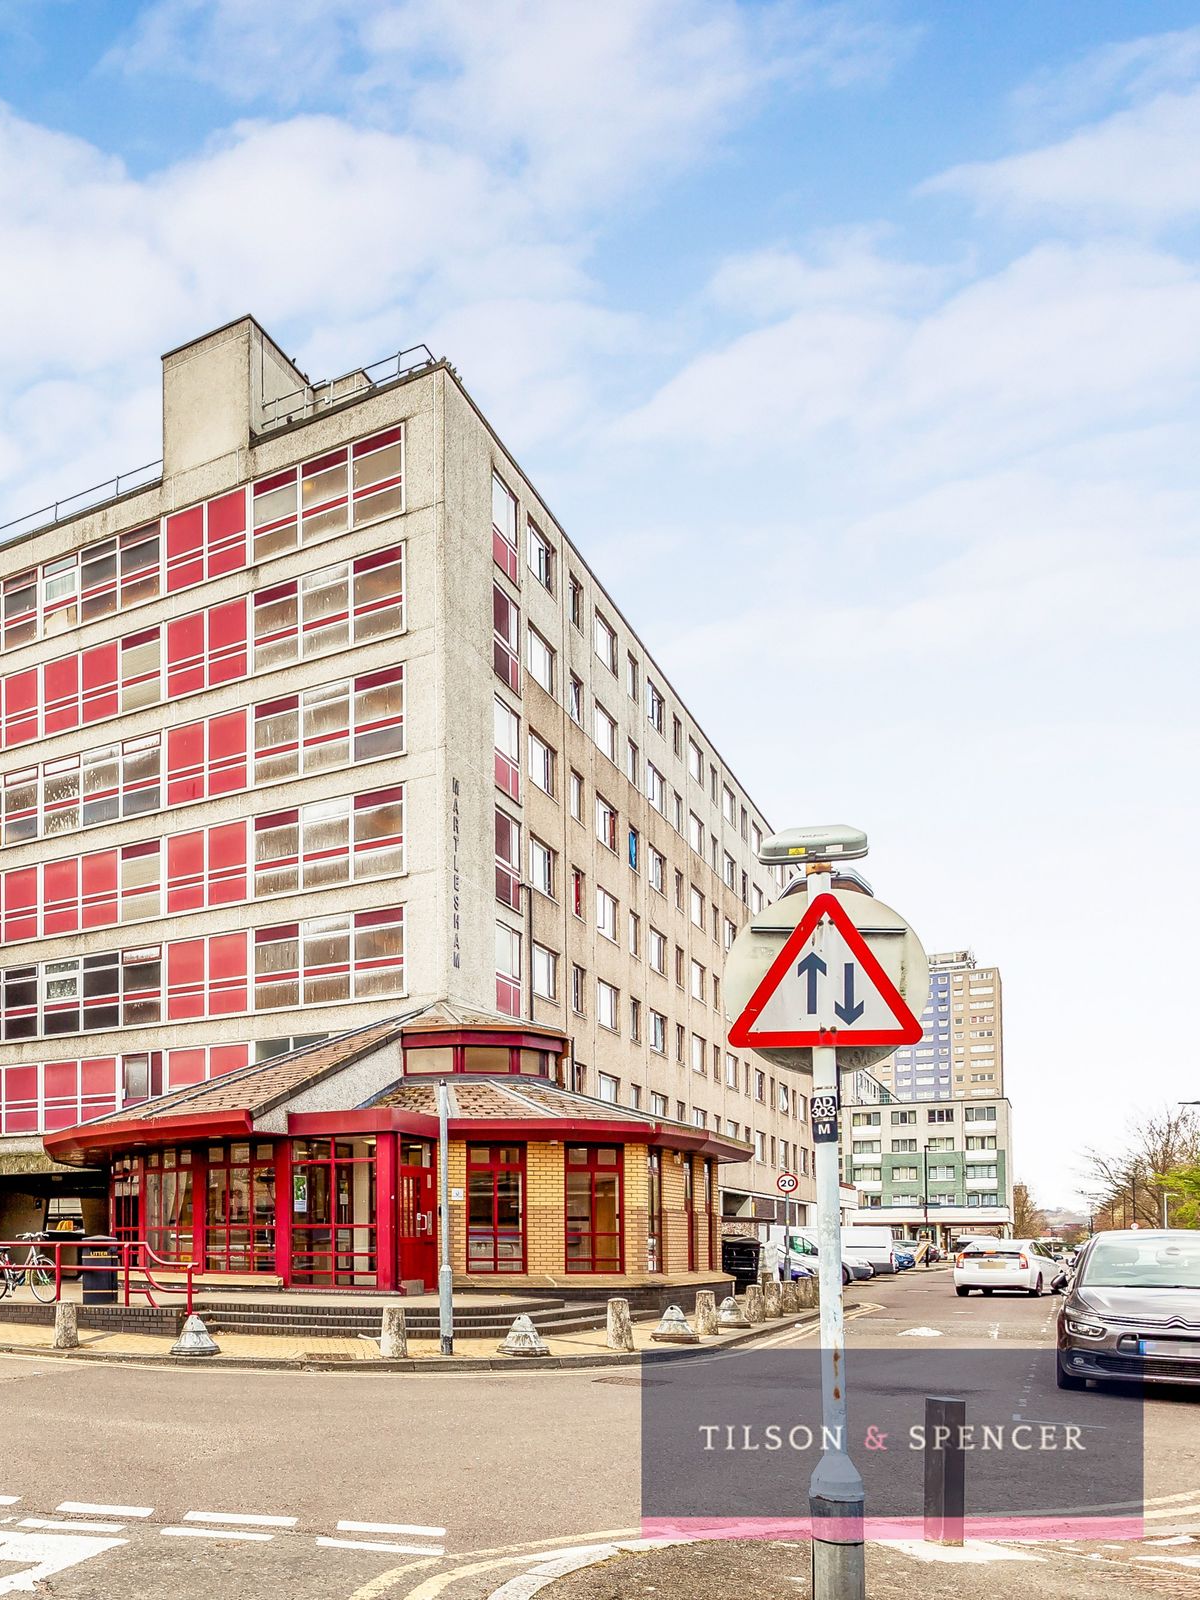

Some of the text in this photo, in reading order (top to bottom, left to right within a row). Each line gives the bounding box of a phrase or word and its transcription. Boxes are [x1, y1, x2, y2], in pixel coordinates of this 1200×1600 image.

[452, 777, 460, 969] MARTLESHAM
[814, 1097, 833, 1108] AD
[811, 1106, 836, 1118] 303
[818, 1123, 831, 1135] M
[780, 1179, 795, 1187] 20
